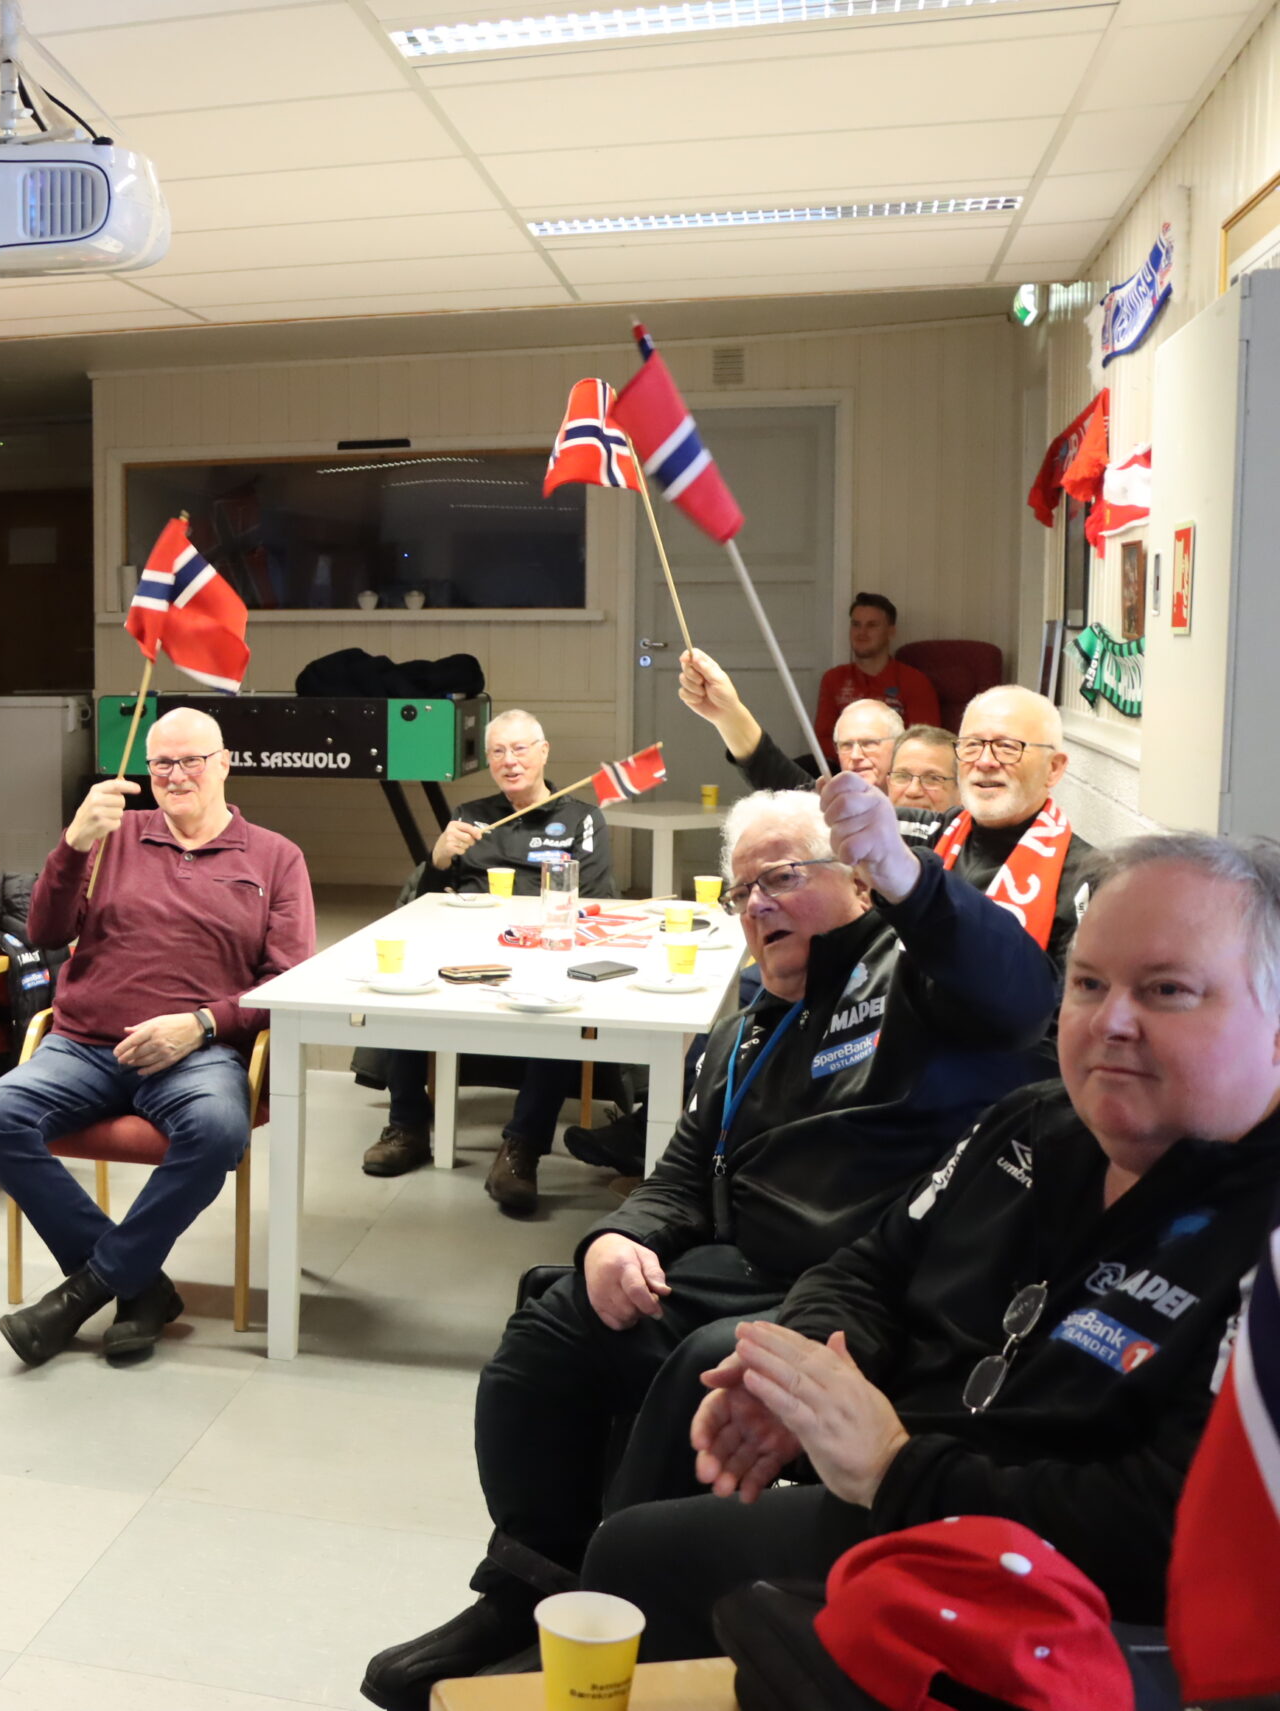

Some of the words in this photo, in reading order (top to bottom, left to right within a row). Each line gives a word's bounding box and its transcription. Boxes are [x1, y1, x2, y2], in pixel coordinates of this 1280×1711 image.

[260, 750, 351, 770] SASSUOLO
[829, 995, 887, 1034] MAPEI
[812, 1036, 873, 1068] SpareBank
[829, 1047, 872, 1072] ØSTLANDET
[1116, 1269, 1200, 1321] APEI
